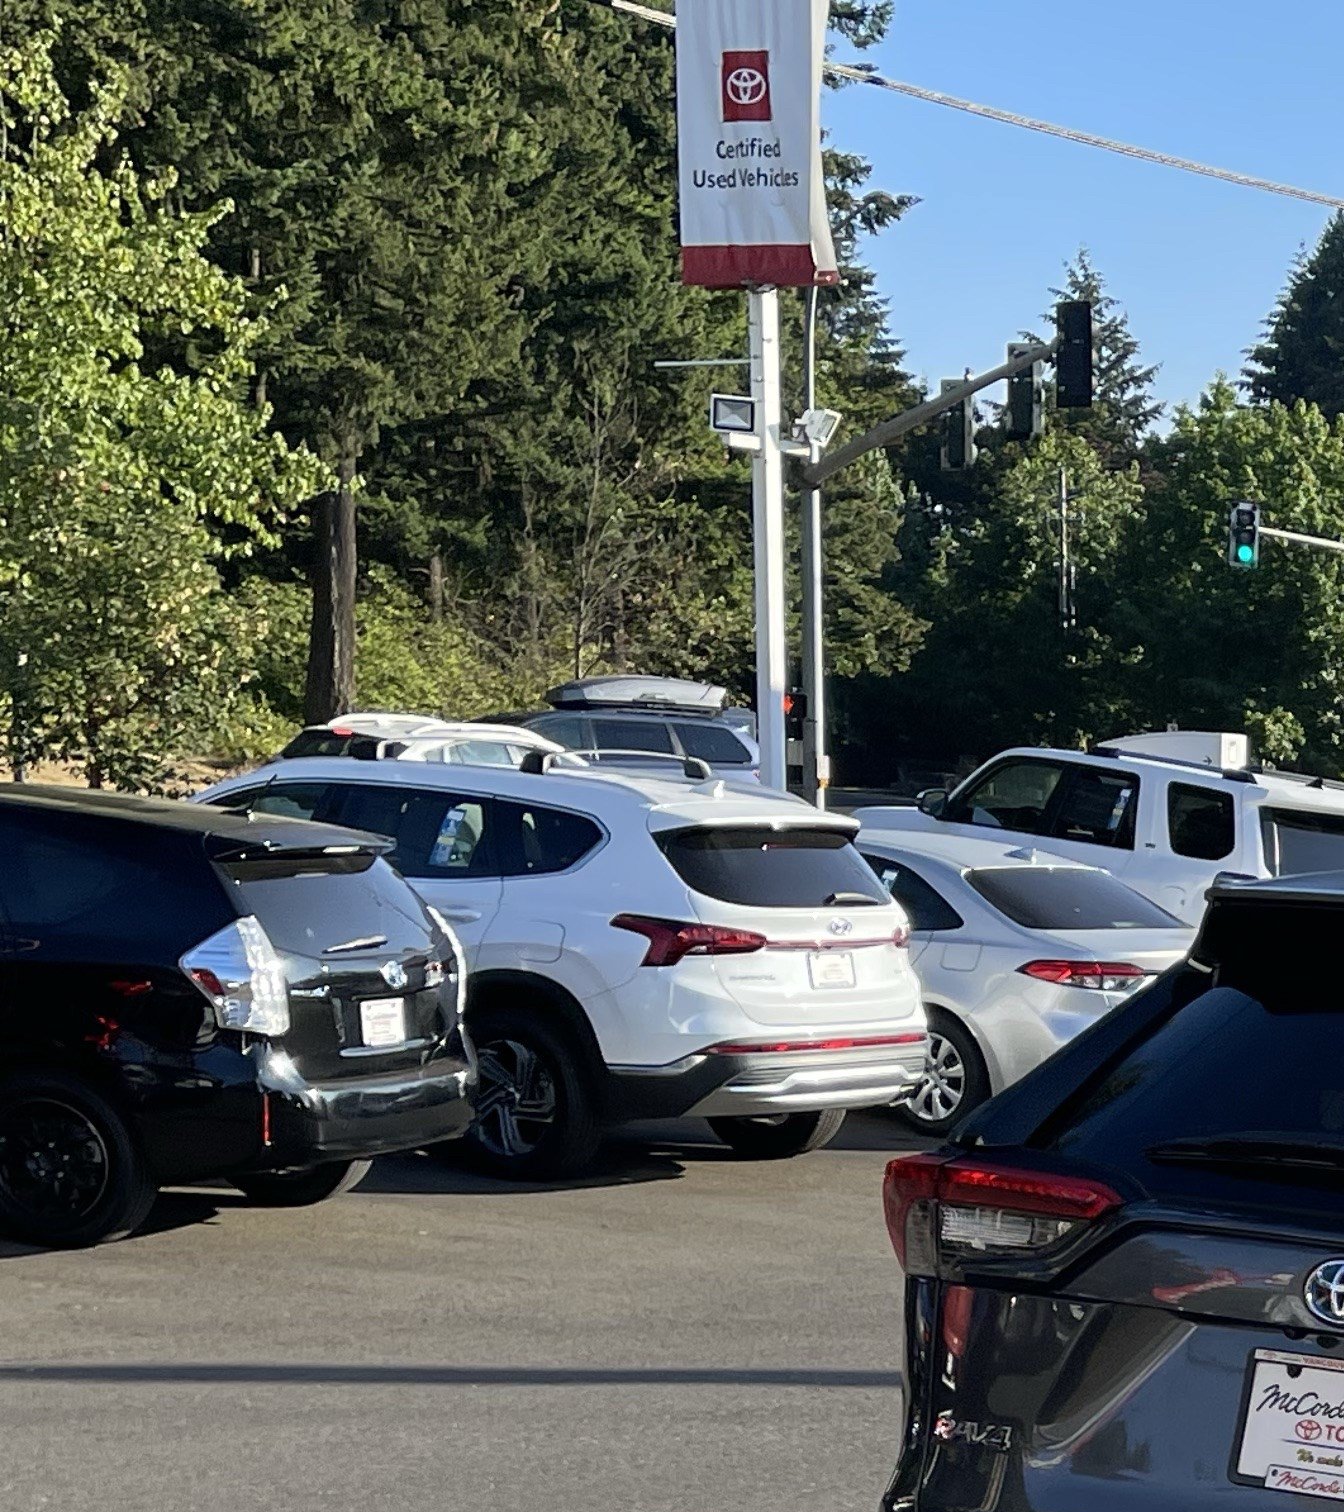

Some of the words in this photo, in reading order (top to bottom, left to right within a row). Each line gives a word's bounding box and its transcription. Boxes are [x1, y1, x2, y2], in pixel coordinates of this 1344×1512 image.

[716, 138, 781, 159] Certified
[693, 170, 737, 188] Used
[740, 167, 799, 188] Vehicles
